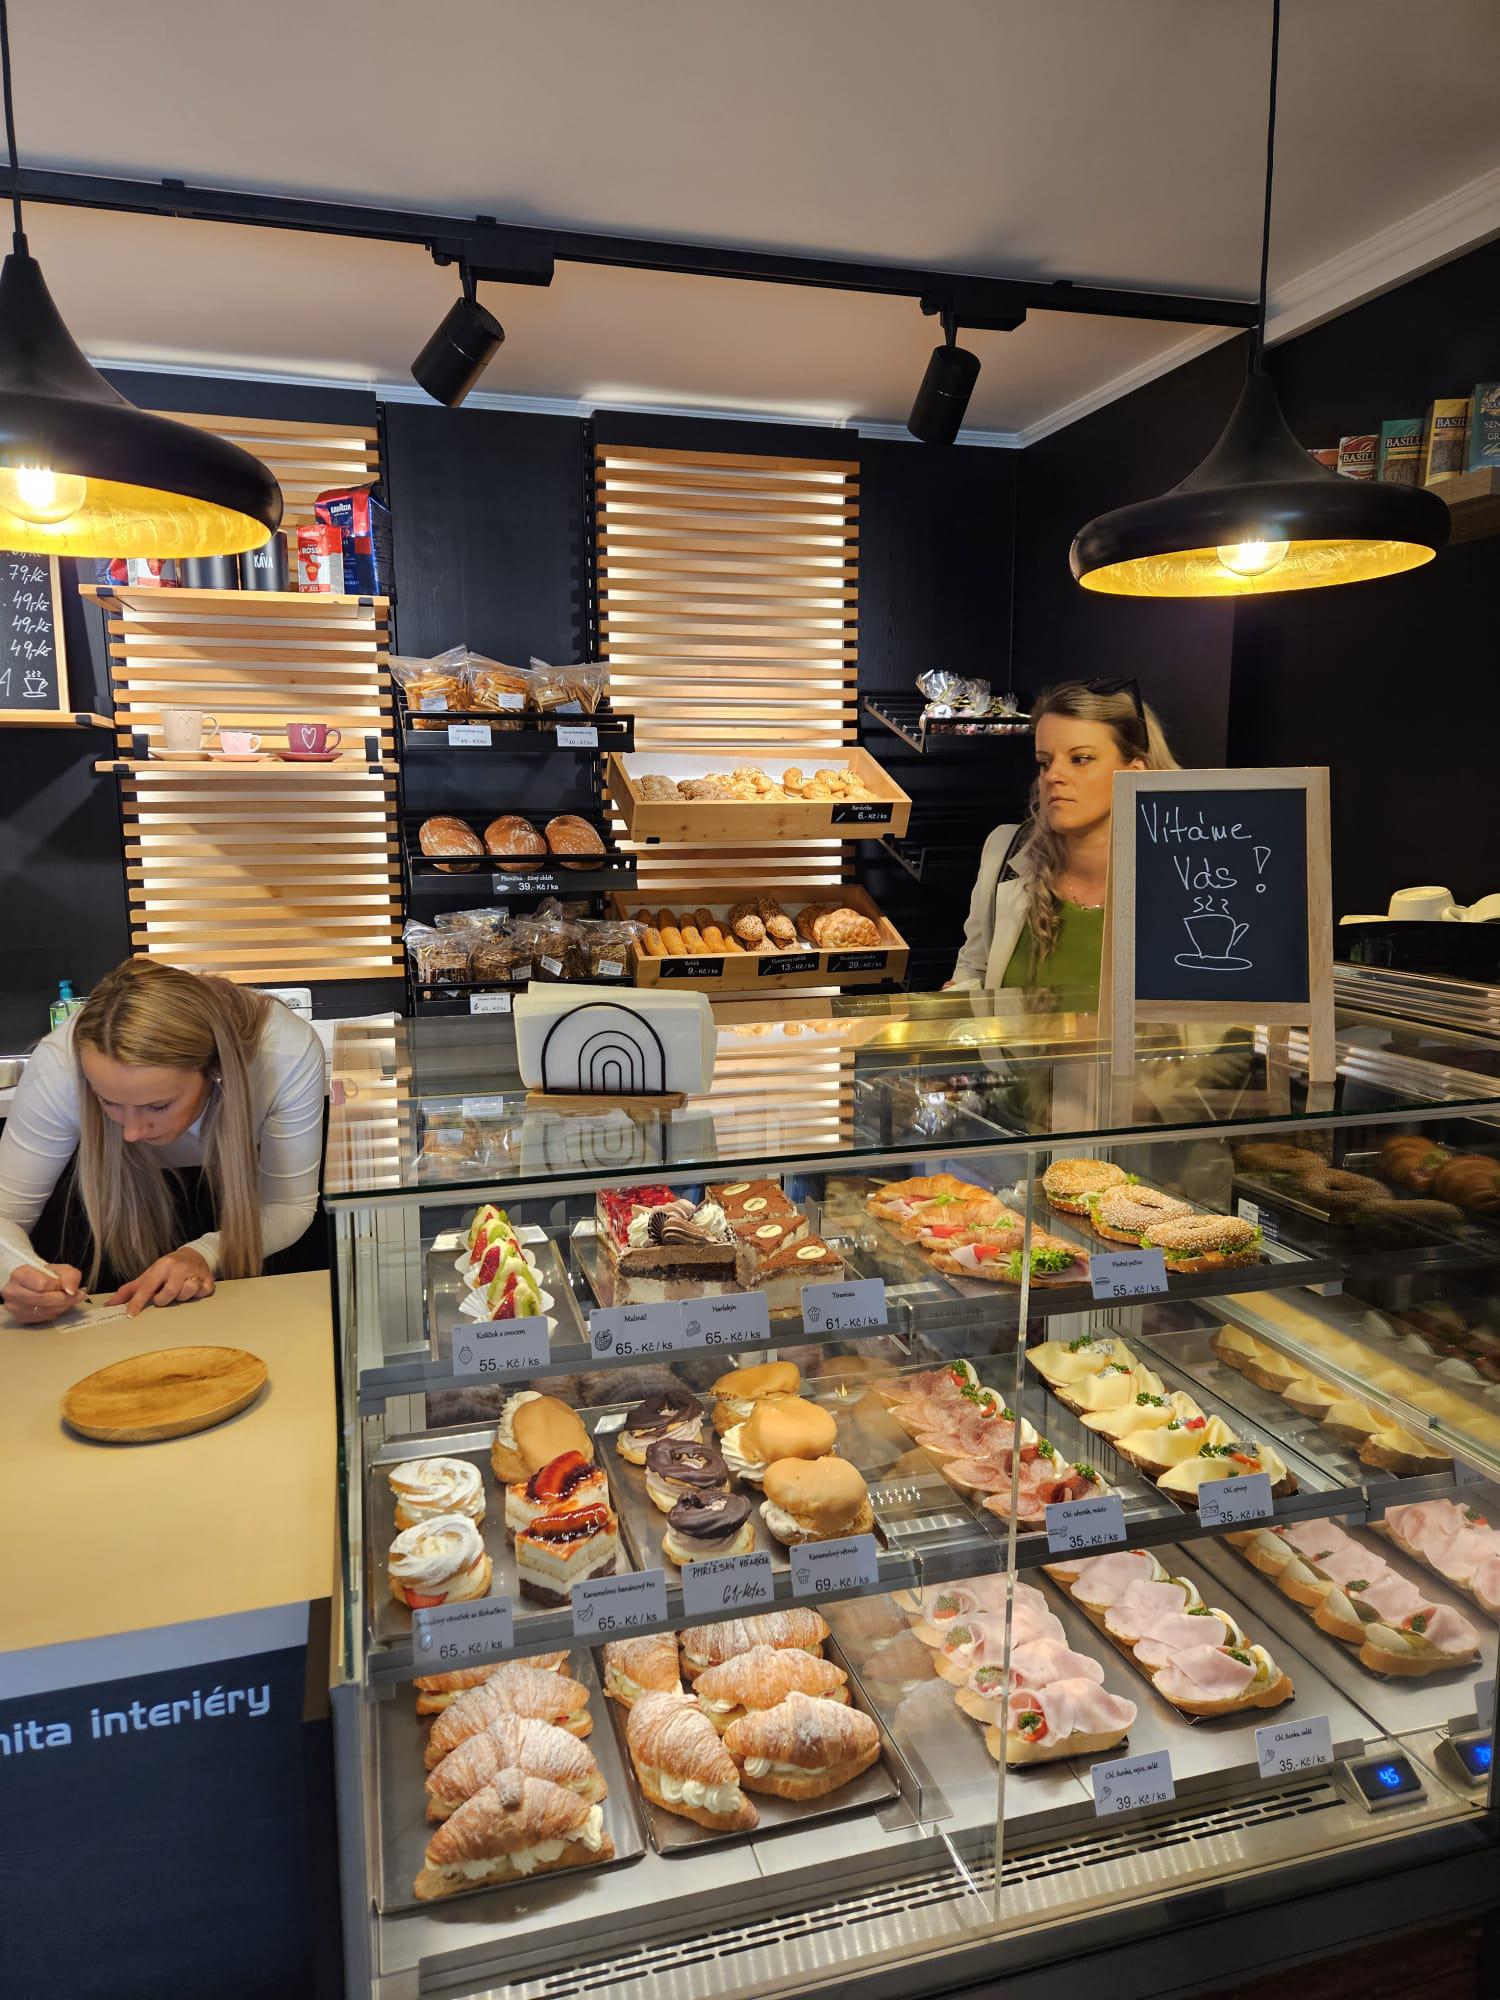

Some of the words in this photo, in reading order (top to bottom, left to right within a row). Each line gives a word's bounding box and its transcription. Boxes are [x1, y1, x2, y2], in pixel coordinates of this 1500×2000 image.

[253, 553, 274, 569] KÁVA
[1141, 802, 1252, 844] Vítáme
[1173, 855, 1238, 890] Vás
[1113, 1284, 1132, 1296] 55,-
[1134, 1285, 1145, 1294] Kč
[1150, 1284, 1161, 1292] ks
[826, 1317, 848, 1330] 61,-
[849, 1318, 862, 1327] Kč
[868, 1316, 879, 1325] ks
[705, 1331, 728, 1345] 65,-
[730, 1331, 743, 1342] Kč
[750, 1330, 761, 1339] ks
[615, 1342, 640, 1355] 65,-
[641, 1343, 654, 1353] Kč
[662, 1341, 673, 1350] ks
[479, 1358, 503, 1372] 55,-
[506, 1359, 520, 1369] Kč
[528, 1357, 540, 1366] ks
[1240, 1510, 1251, 1520] Kč
[1257, 1509, 1266, 1517] ks
[1069, 1534, 1090, 1548] 35,-
[1091, 1534, 1103, 1544] Kč
[1108, 1533, 1119, 1541] ks
[815, 1577, 838, 1592] 69,-
[839, 1577, 852, 1588] Kč
[859, 1575, 870, 1585] ks
[598, 1615, 622, 1631] 65,-
[625, 1615, 638, 1626] Kč
[646, 1612, 657, 1622] ks
[440, 1643, 465, 1659] 65,-
[468, 1643, 482, 1654] Kč
[491, 1640, 503, 1650] ks
[90, 1684, 271, 1739] interiéry
[1279, 1758, 1299, 1772] 35,-
[1300, 1757, 1311, 1768] Kč
[1316, 1755, 1326, 1763] ks
[1138, 1794, 1151, 1806] Kč
[1157, 1791, 1167, 1800] ks
